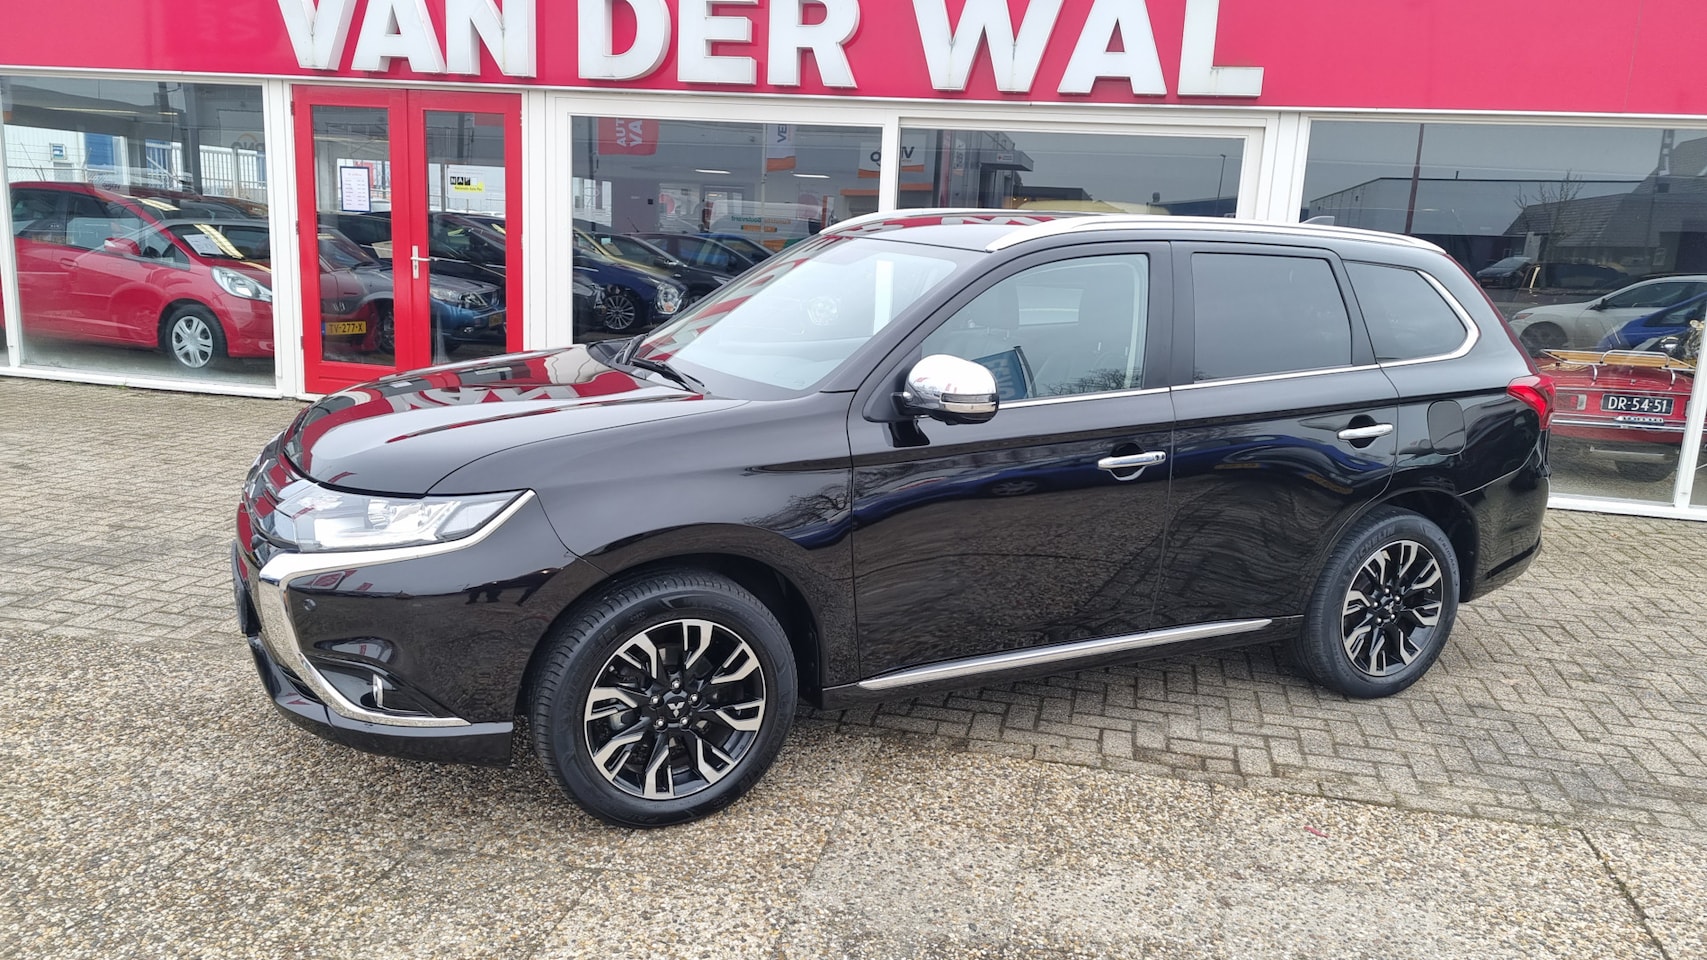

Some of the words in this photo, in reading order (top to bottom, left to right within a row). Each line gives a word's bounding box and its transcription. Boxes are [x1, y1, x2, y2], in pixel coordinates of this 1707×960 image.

[277, 0, 536, 77] VAN
[577, 0, 860, 89] DER
[912, 0, 1265, 97] WAL
[1607, 396, 1668, 413] DR-54-51
[1348, 523, 1396, 572] MICHELIN
